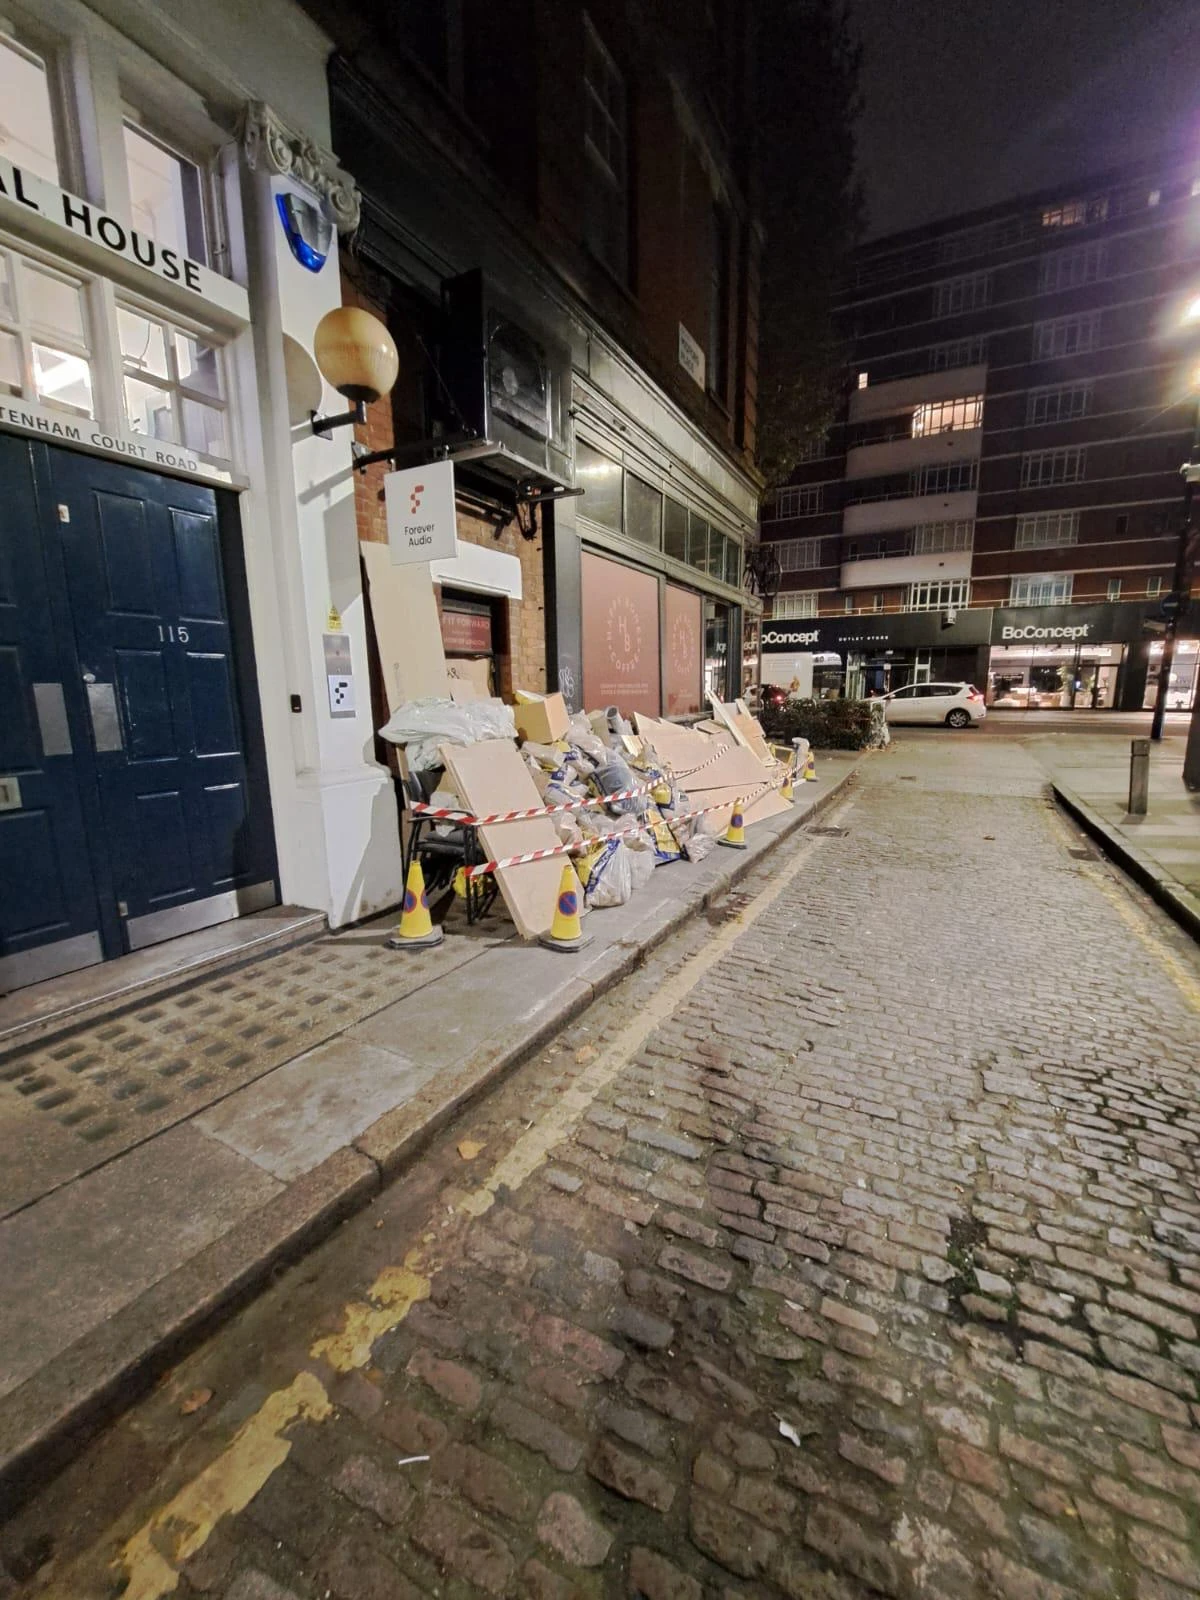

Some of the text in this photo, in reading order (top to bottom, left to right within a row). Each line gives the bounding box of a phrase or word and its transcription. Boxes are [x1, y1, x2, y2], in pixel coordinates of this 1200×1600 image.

[62, 193, 203, 293] HOUSE
[91, 433, 147, 458] COURT
[155, 451, 198, 473] ROAD
[404, 523, 435, 536] Forever
[408, 536, 433, 547] Audio
[158, 625, 190, 643] 115
[761, 629, 819, 645] oConcept
[1002, 624, 1089, 640] BoConcept
